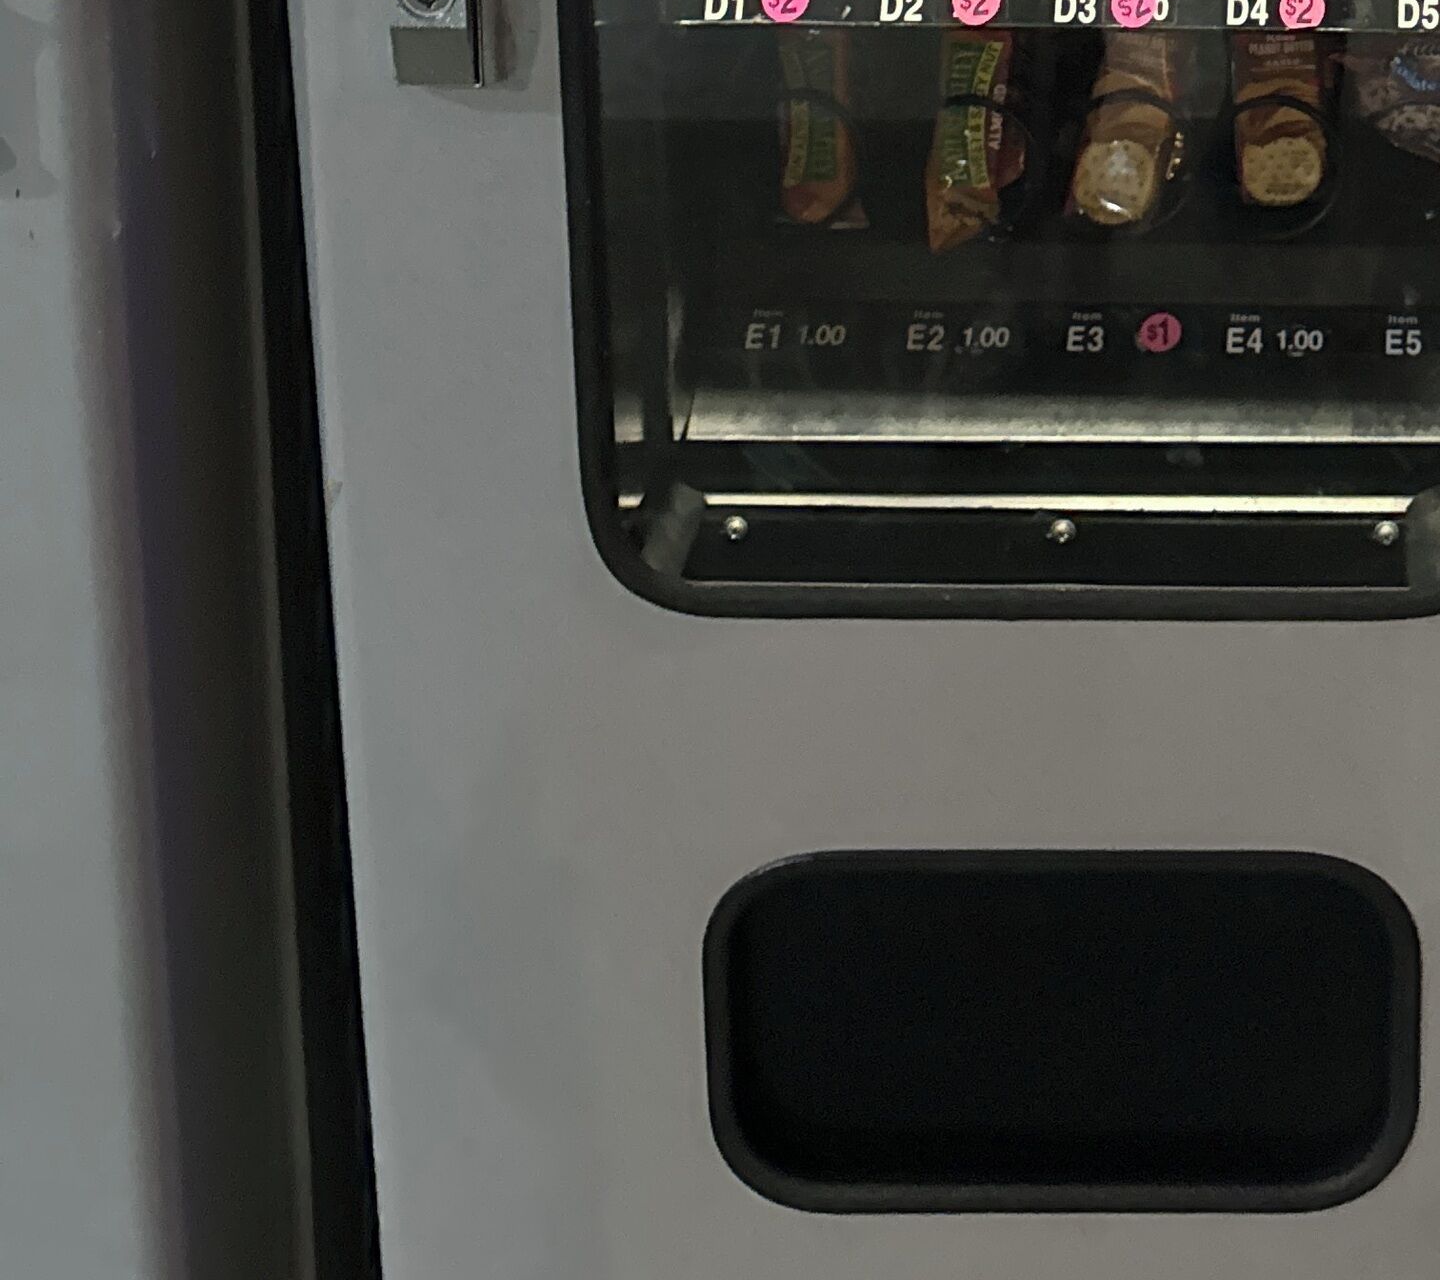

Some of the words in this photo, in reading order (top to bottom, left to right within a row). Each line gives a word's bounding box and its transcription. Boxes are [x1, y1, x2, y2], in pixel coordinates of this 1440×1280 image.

[1230, 312, 1261, 323] Item
[1388, 314, 1418, 325] Item
[745, 323, 781, 349] E1
[799, 325, 845, 346] 1.00
[906, 324, 944, 351] E2
[963, 327, 1010, 348] 1.00
[1065, 326, 1104, 352] E3
[1147, 319, 1171, 346] $1
[1225, 327, 1264, 354] E4
[1276, 329, 1324, 351] 1.00
[1384, 329, 1422, 356] E5
